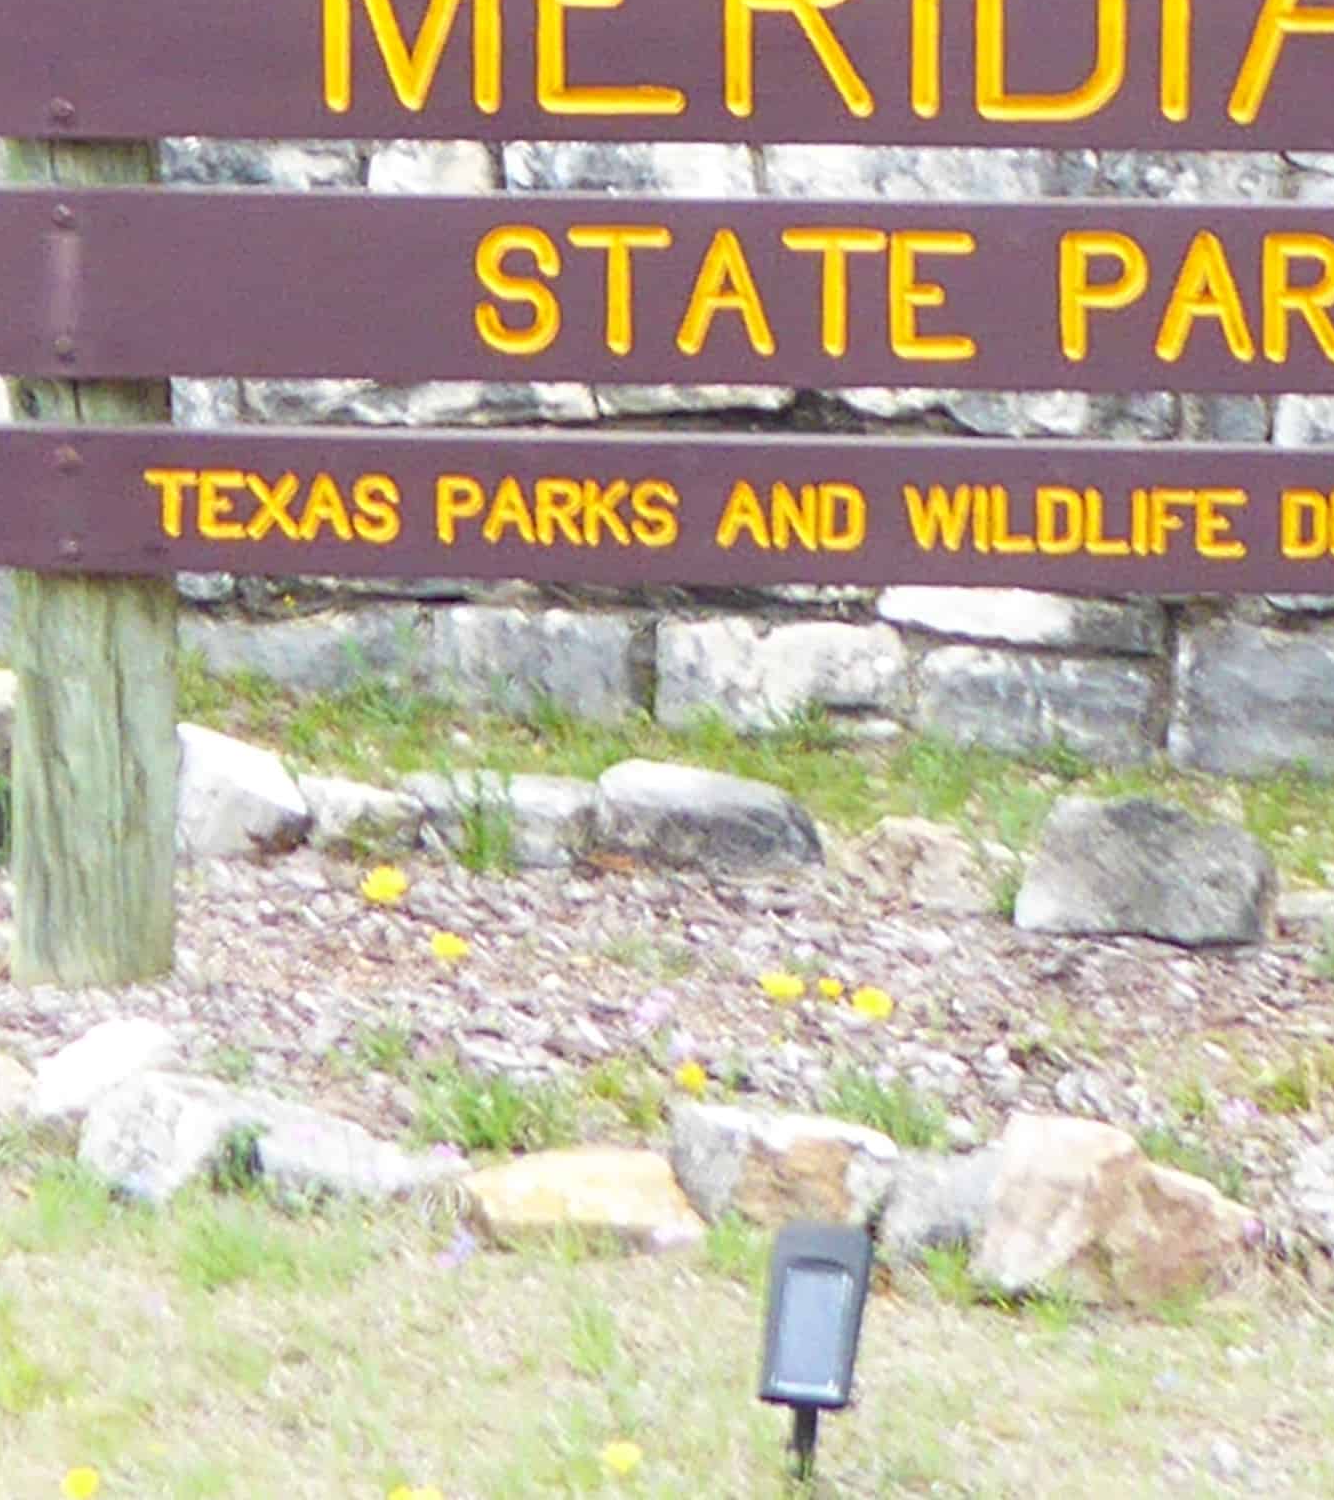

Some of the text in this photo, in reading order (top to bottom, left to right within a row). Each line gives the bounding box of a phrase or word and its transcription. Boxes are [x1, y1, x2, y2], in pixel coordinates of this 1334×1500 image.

[473, 223, 978, 364] STATE
[143, 468, 401, 546] TEXAS
[434, 474, 681, 550] PARKS
[714, 479, 869, 554] AND
[901, 483, 1249, 563] WILDLIFE
